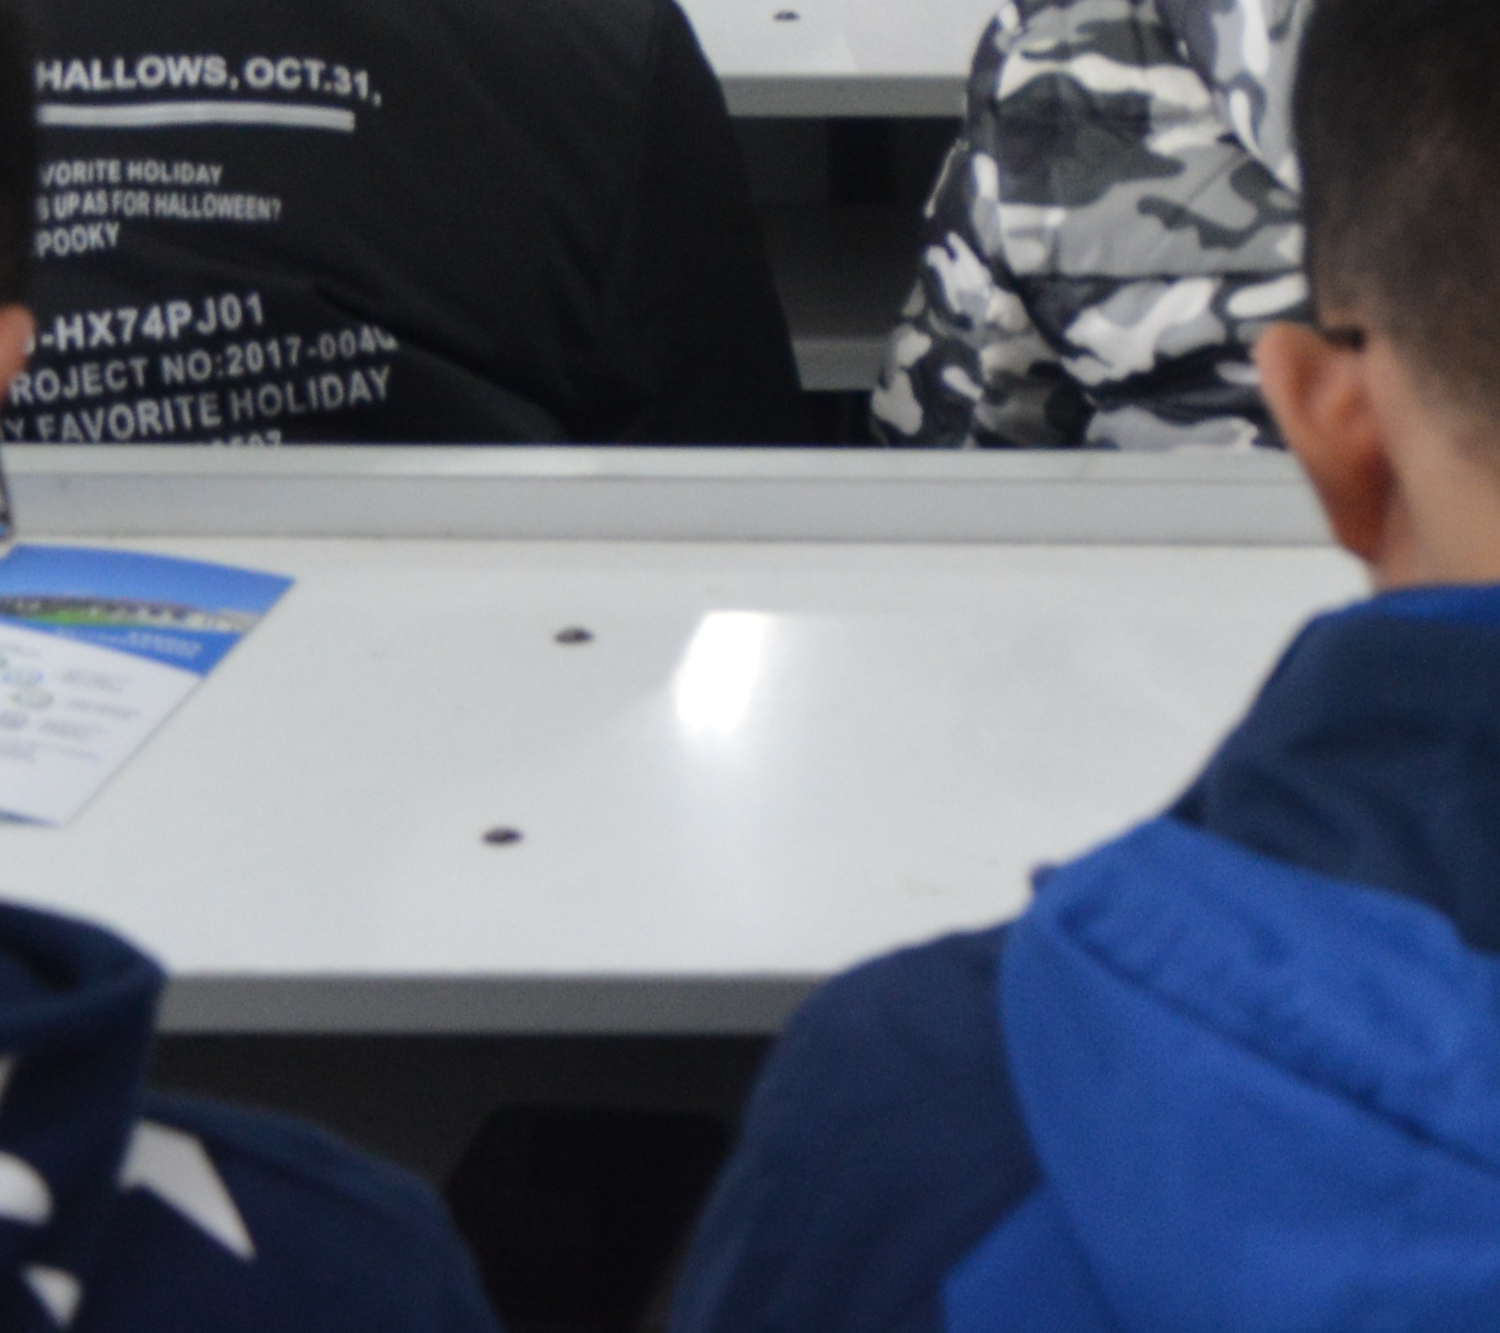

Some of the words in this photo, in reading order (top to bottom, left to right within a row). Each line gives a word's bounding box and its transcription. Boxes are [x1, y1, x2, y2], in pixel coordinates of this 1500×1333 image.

[125, 160, 223, 186] HOLIDAY
[111, 190, 149, 219] FOR
[153, 191, 282, 223] HALLOWEEN?
[24, 293, 265, 355] -HX74PJ01
[39, 393, 222, 442] FAVORITE
[229, 364, 392, 421] HOLIDAY
